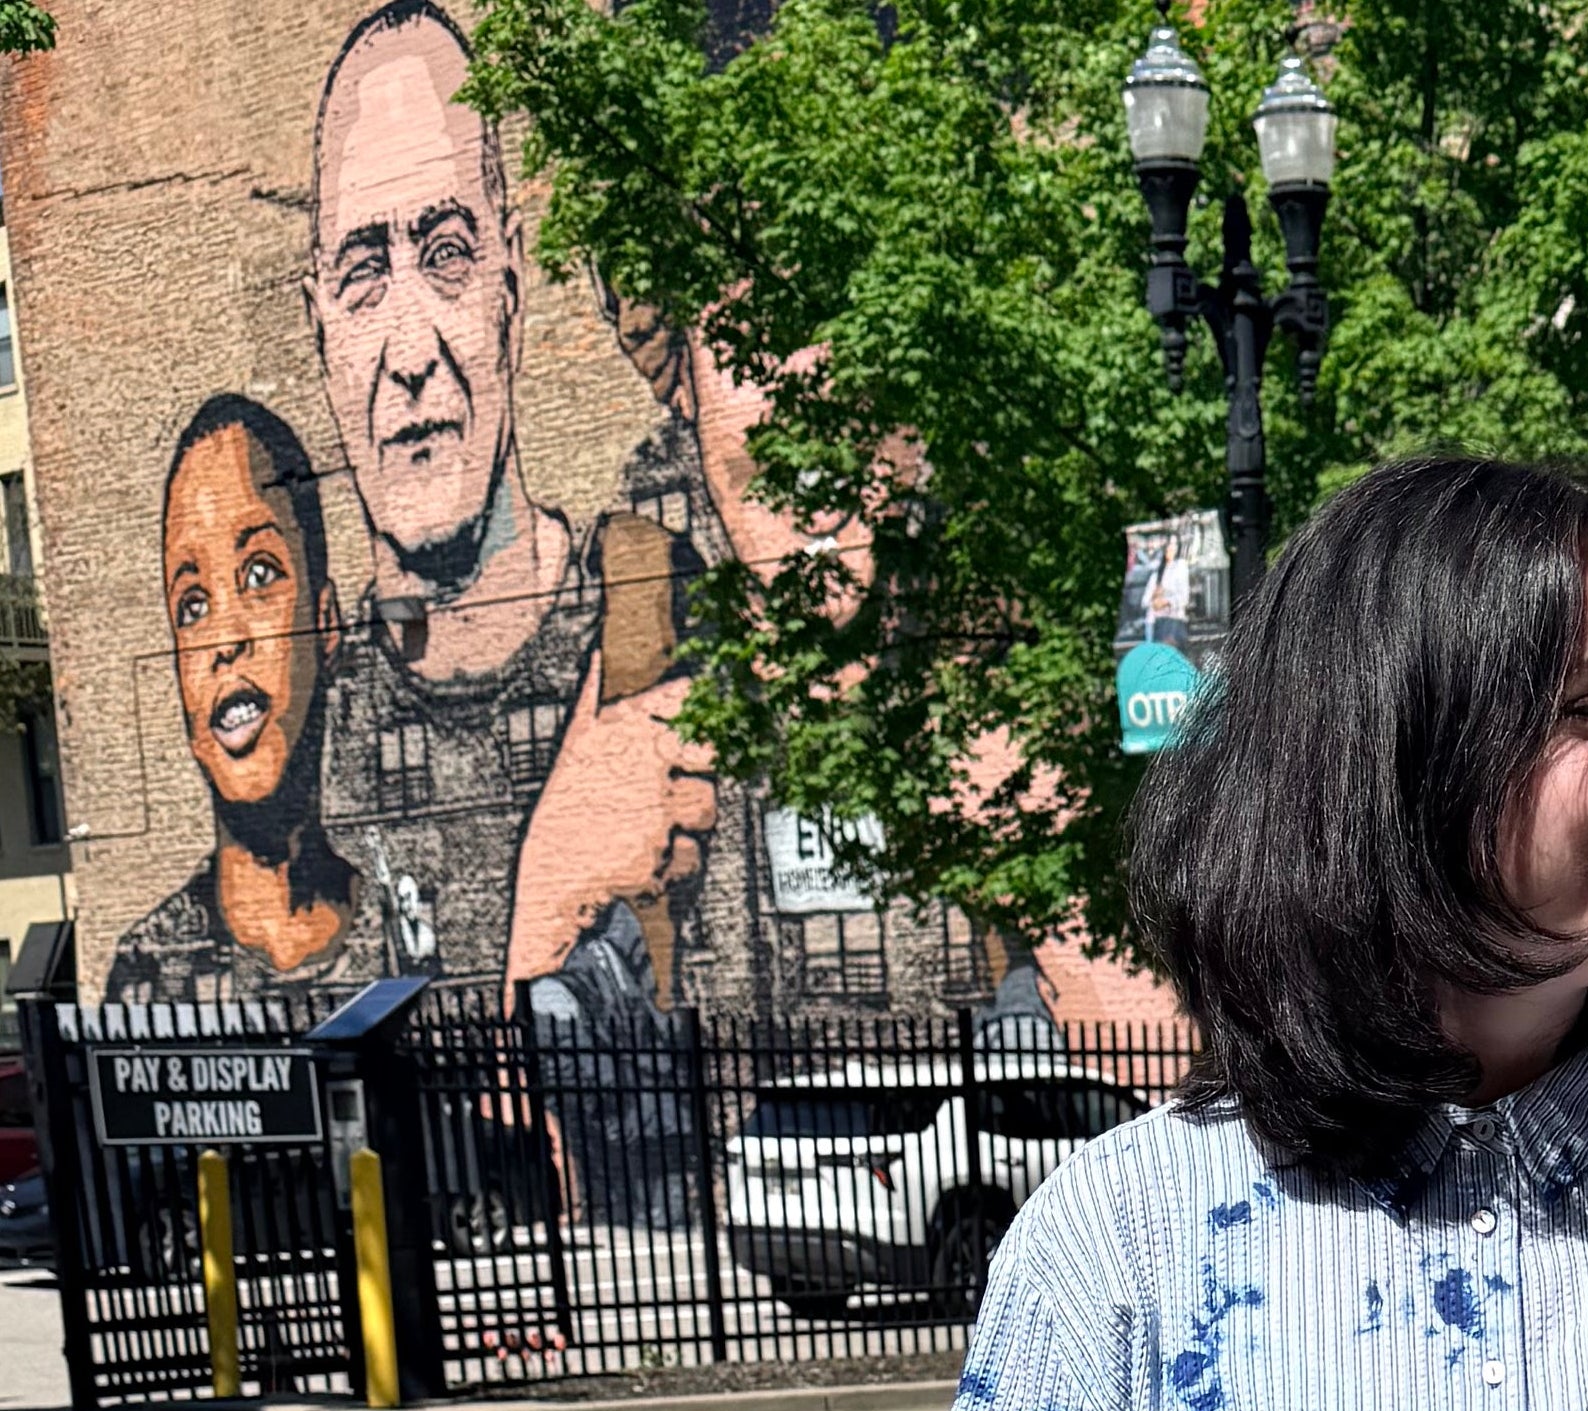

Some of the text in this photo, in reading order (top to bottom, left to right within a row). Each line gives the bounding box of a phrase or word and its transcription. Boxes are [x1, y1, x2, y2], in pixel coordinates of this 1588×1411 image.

[113, 1055, 292, 1093] PAY & DISPLAY
[153, 1100, 264, 1137] PARKING
